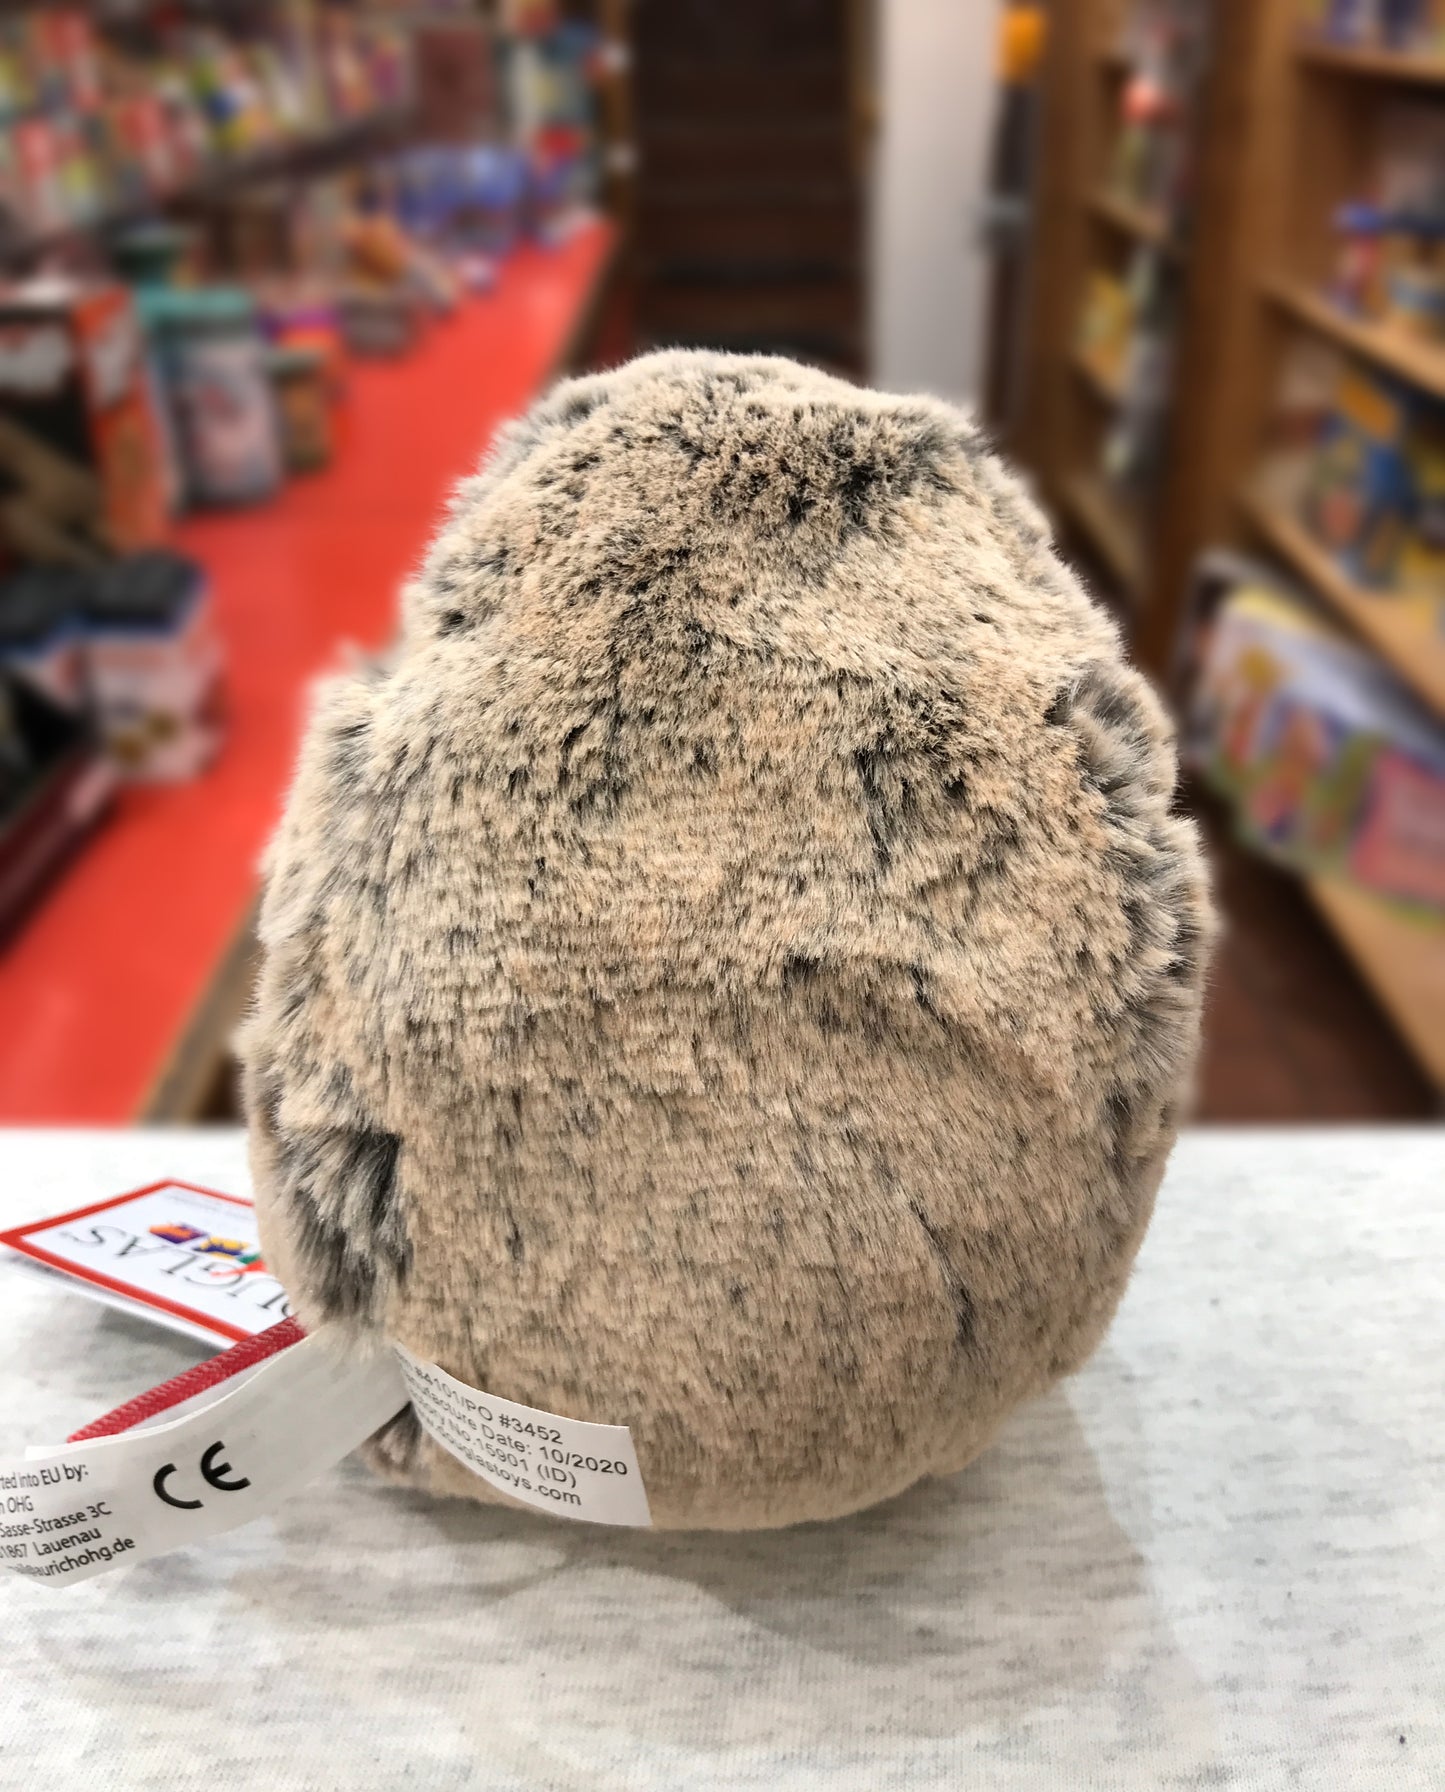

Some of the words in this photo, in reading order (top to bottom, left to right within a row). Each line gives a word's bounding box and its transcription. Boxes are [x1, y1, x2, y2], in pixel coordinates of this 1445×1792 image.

[68, 1225, 291, 1316] UGLAS
[498, 1413, 564, 1445] #3452
[481, 1423, 532, 1456] Date:
[539, 1446, 628, 1476] 10/2020
[19, 1472, 39, 1488] into
[39, 1466, 61, 1486] EU
[62, 1463, 89, 1482] by:
[537, 1463, 577, 1489] (ID)
[7, 1495, 34, 1514] OHG
[86, 1501, 112, 1518] 3C
[32, 1527, 102, 1556] Lauenau
